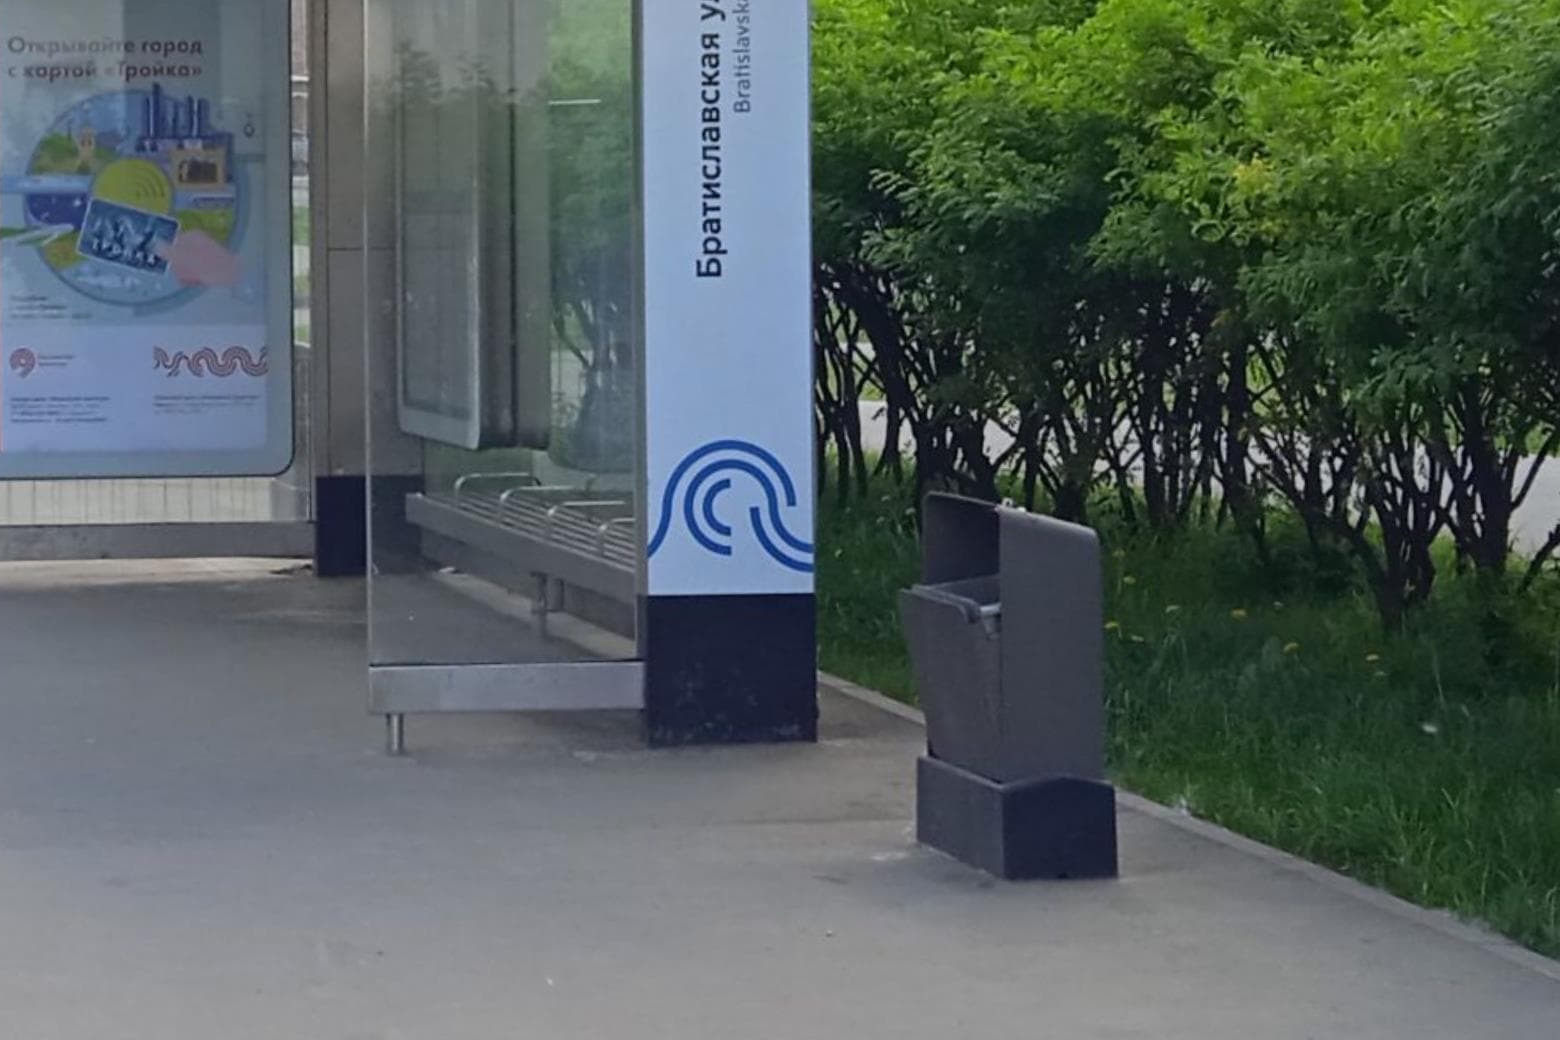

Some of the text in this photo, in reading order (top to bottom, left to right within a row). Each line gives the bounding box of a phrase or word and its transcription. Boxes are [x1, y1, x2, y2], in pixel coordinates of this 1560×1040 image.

[7, 35, 203, 58] Открывайте город
[8, 60, 203, 83] с картой «Тройка»
[696, 33, 728, 279] Братиславская
